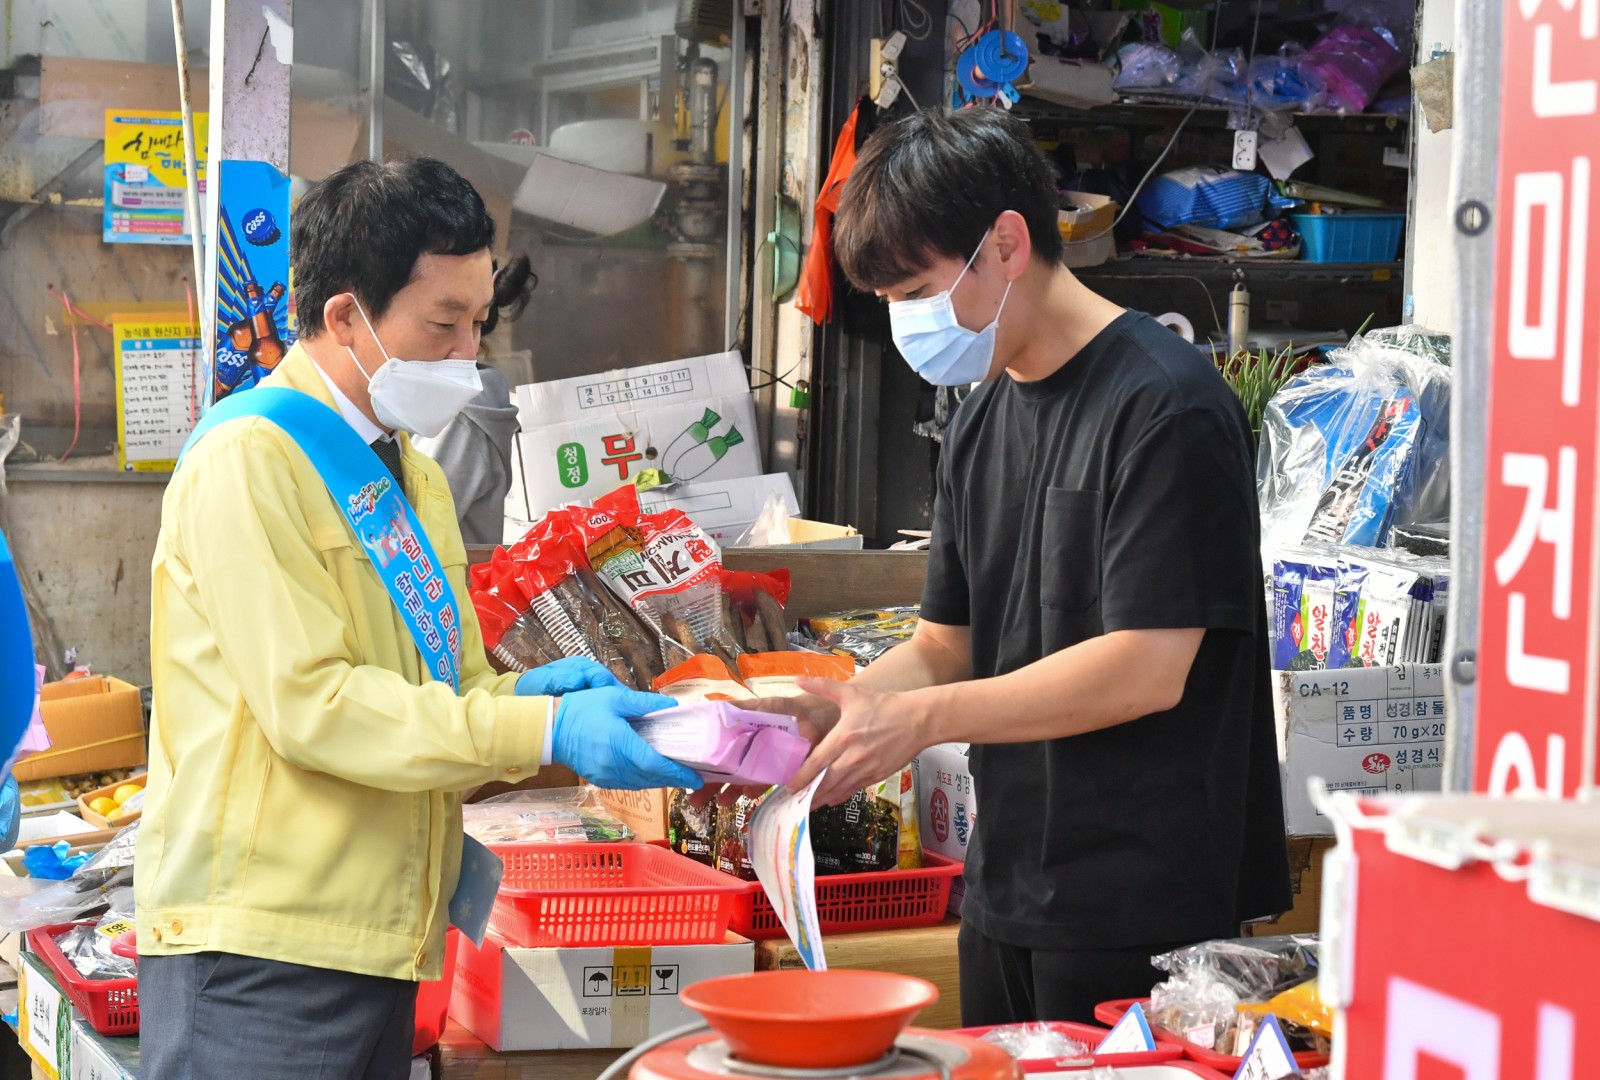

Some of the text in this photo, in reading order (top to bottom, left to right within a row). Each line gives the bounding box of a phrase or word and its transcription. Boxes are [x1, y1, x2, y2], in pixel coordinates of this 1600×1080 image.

[245, 211, 267, 234] Cass
[624, 381, 630, 389] 8
[624, 391, 634, 399] 13
[642, 388, 652, 396] 14
[661, 385, 670, 393] 15
[1488, 0, 1598, 798] 미건
[564, 446, 582, 484] 청정
[601, 433, 643, 480] 무
[589, 513, 613, 527] 00g
[401, 533, 443, 602] 힘내라
[396, 571, 443, 653] 함께하면
[1299, 682, 1350, 698] CA-12
[936, 769, 953, 787] 지도표
[934, 798, 947, 834] 참
